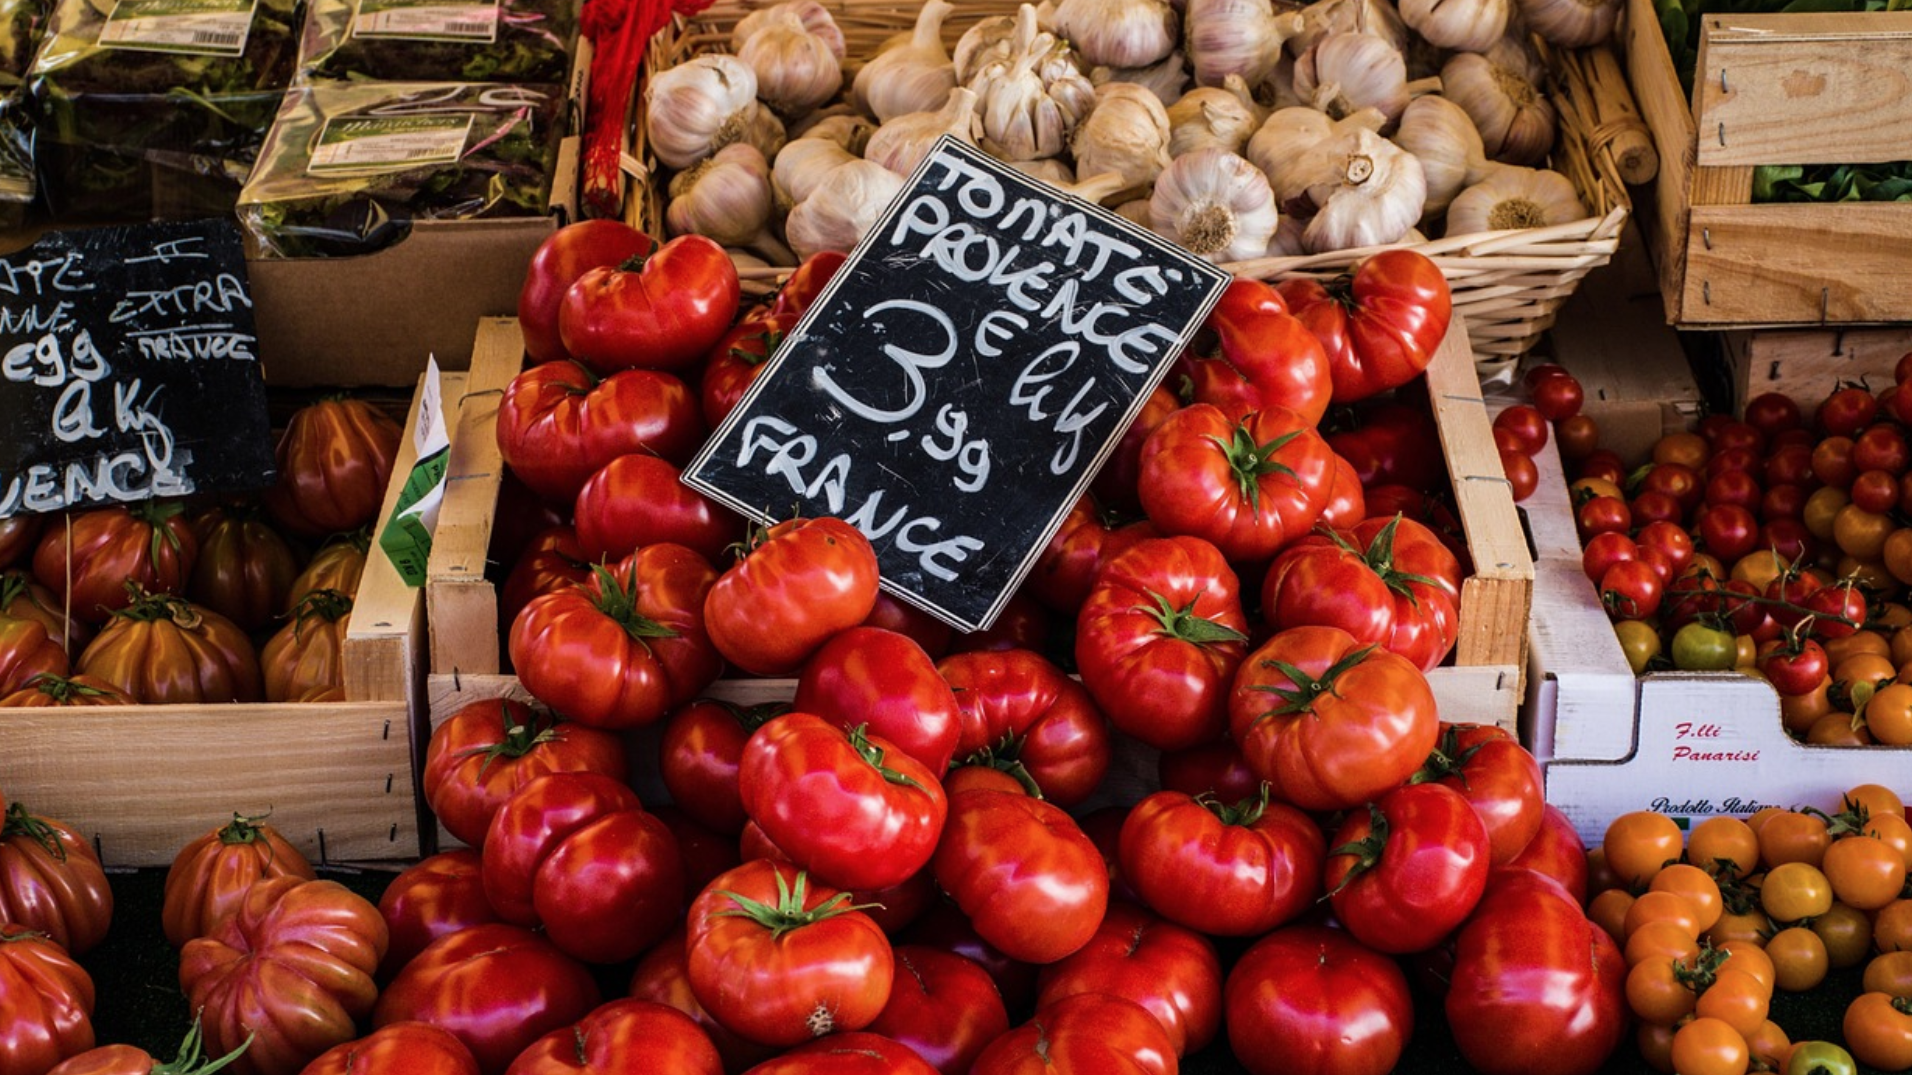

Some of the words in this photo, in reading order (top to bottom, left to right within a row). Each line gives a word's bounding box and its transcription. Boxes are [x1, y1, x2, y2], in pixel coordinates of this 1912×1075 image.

[109, 273, 252, 322] EXTRA
[891, 195, 1178, 373] PROVENCE
[736, 415, 985, 581] FRANCE
[1675, 722, 1721, 739] F.lli
[1673, 746, 1760, 761] Panarisi
[1648, 796, 1713, 813] Prodotto
